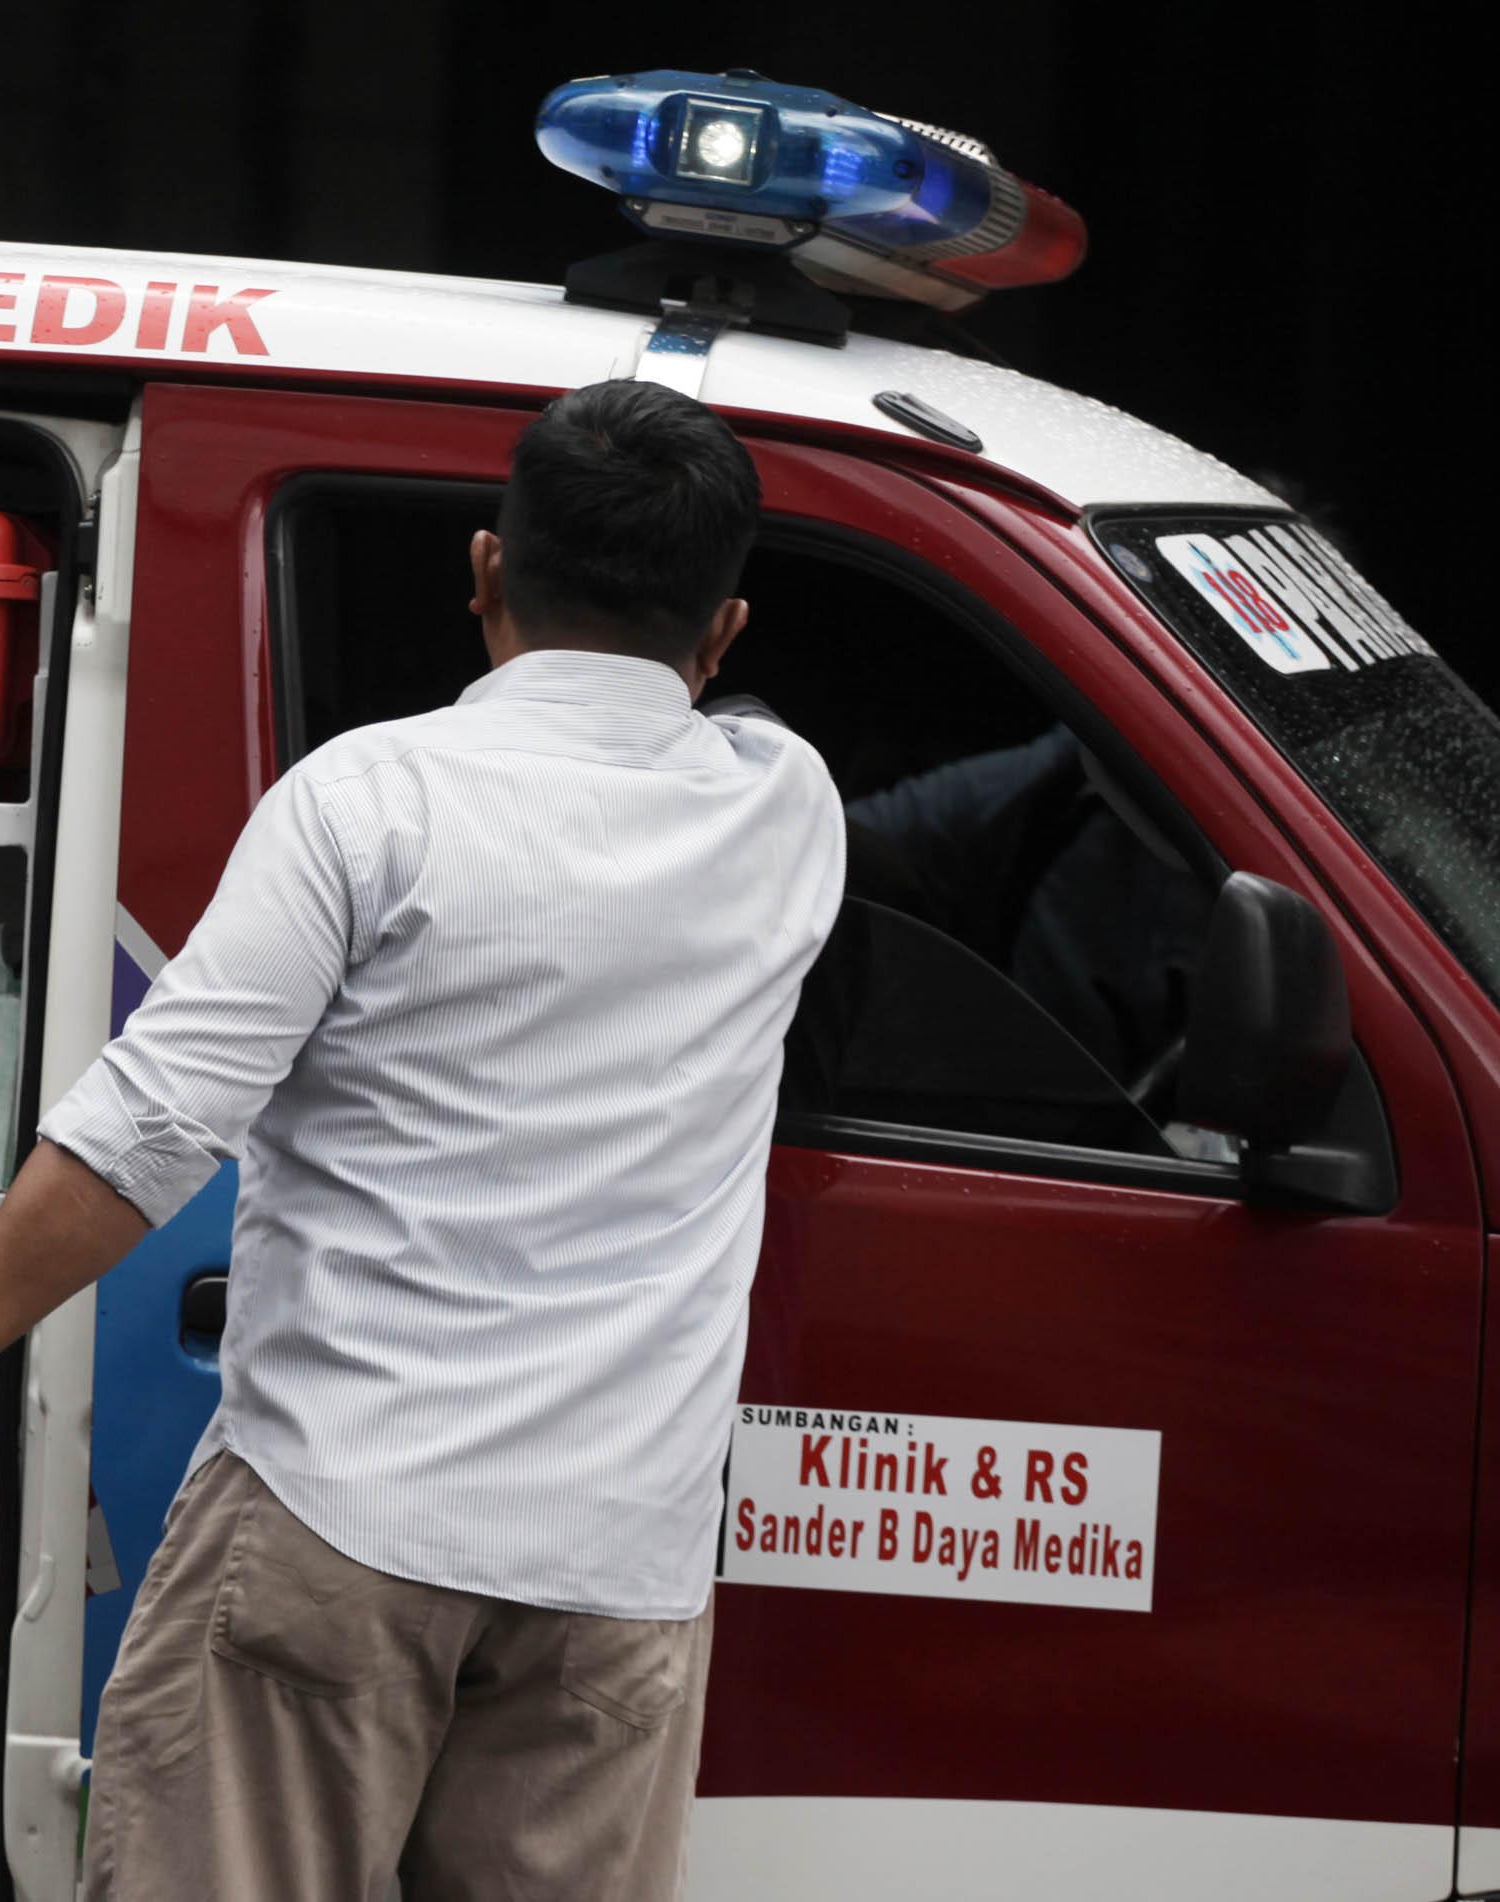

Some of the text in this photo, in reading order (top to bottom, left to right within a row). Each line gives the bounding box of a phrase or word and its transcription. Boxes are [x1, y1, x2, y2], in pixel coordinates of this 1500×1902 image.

[799, 1433, 1089, 1507] Klinik & RS
[734, 1497, 1143, 1582] Sander B Daya Medika
